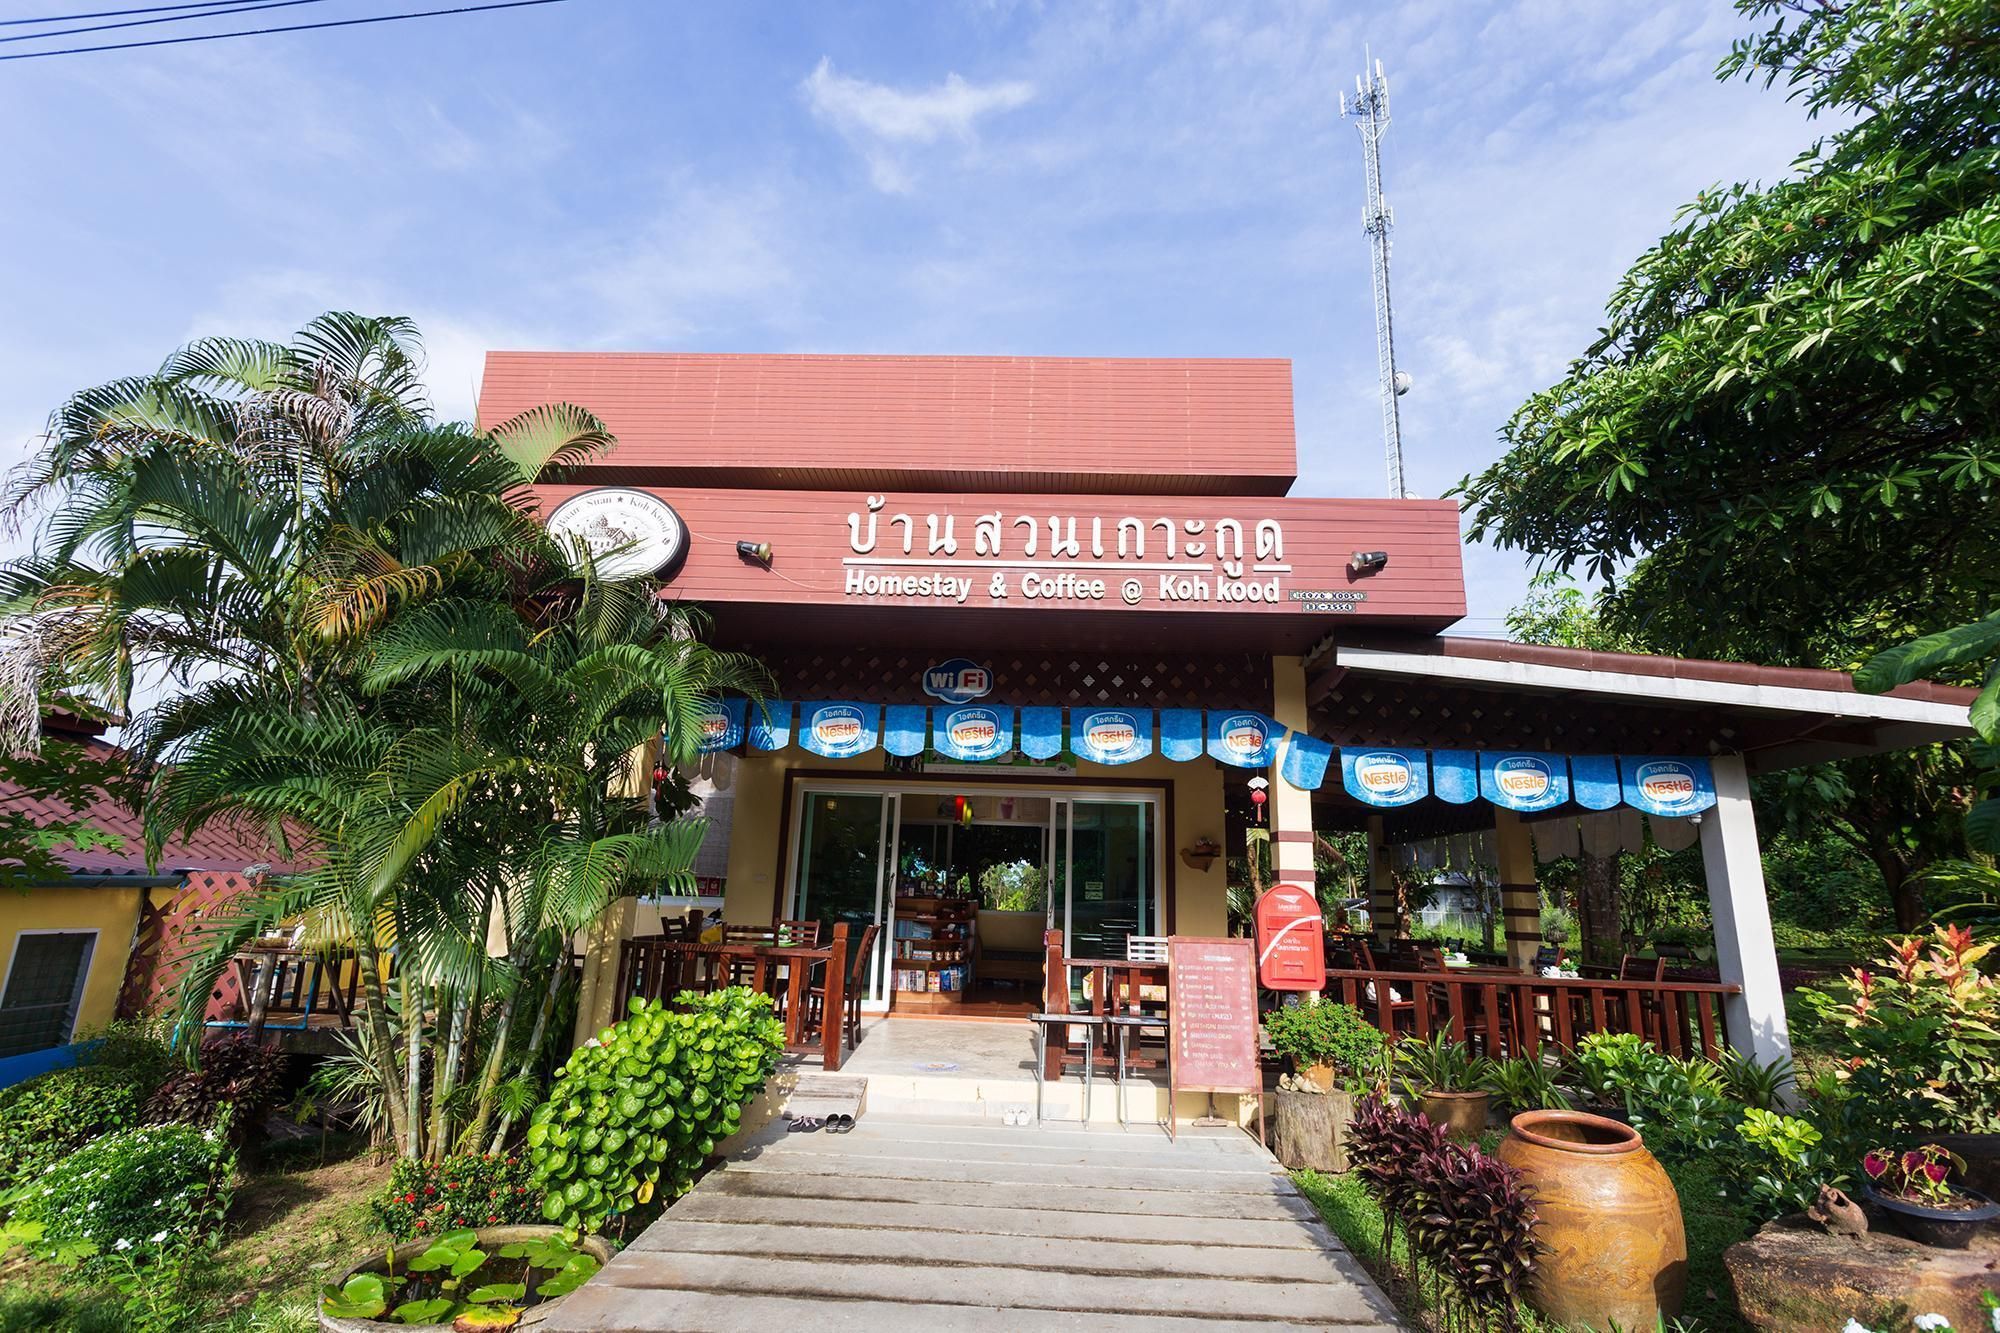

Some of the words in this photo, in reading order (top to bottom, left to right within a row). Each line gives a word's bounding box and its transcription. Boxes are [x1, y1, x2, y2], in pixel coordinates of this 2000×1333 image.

[629, 497, 650, 511] Koh
[650, 507, 671, 533] Kood
[844, 567, 973, 603] Homestay
[988, 571, 1008, 598] &
[1021, 571, 1106, 599] Coffee
[1120, 577, 1143, 604] @
[1159, 574, 1211, 601] Koh
[1215, 575, 1281, 603] kood
